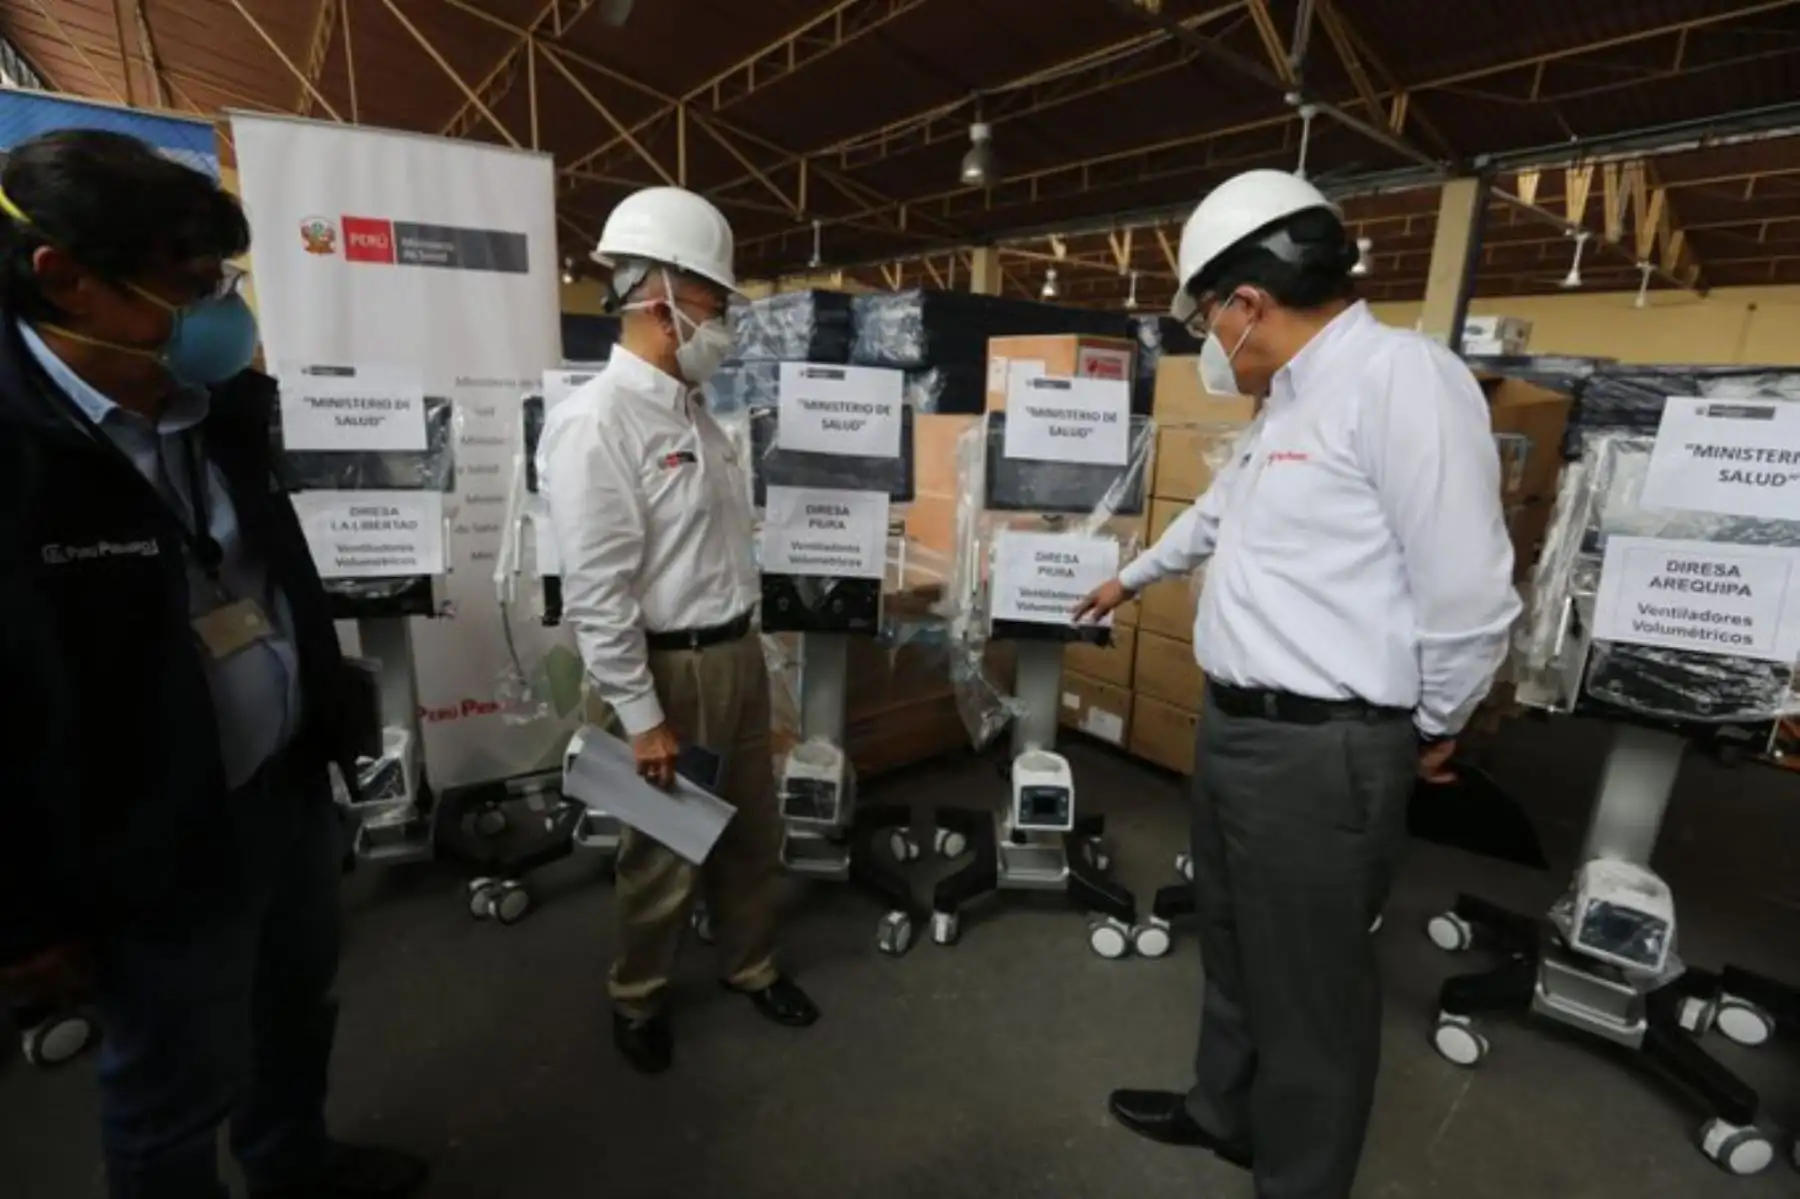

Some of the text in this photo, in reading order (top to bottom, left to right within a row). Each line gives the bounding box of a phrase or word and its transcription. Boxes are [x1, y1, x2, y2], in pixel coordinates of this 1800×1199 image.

[349, 231, 389, 249] PERÚ
[876, 404, 891, 416] DE
[1102, 411, 1117, 423] DE
[821, 419, 867, 432] SALUD"
[1718, 468, 1800, 488] SALUD"
[806, 504, 850, 516] DIRESA
[809, 518, 846, 530] PIURA
[1034, 551, 1080, 564] DIRESA
[1038, 566, 1075, 578] PIURA
[1666, 559, 1741, 578] DIRESA
[1650, 576, 1752, 597] AREQUIPA
[1638, 602, 1753, 627] Ventiladores
[1632, 619, 1753, 646] Volumétricos
